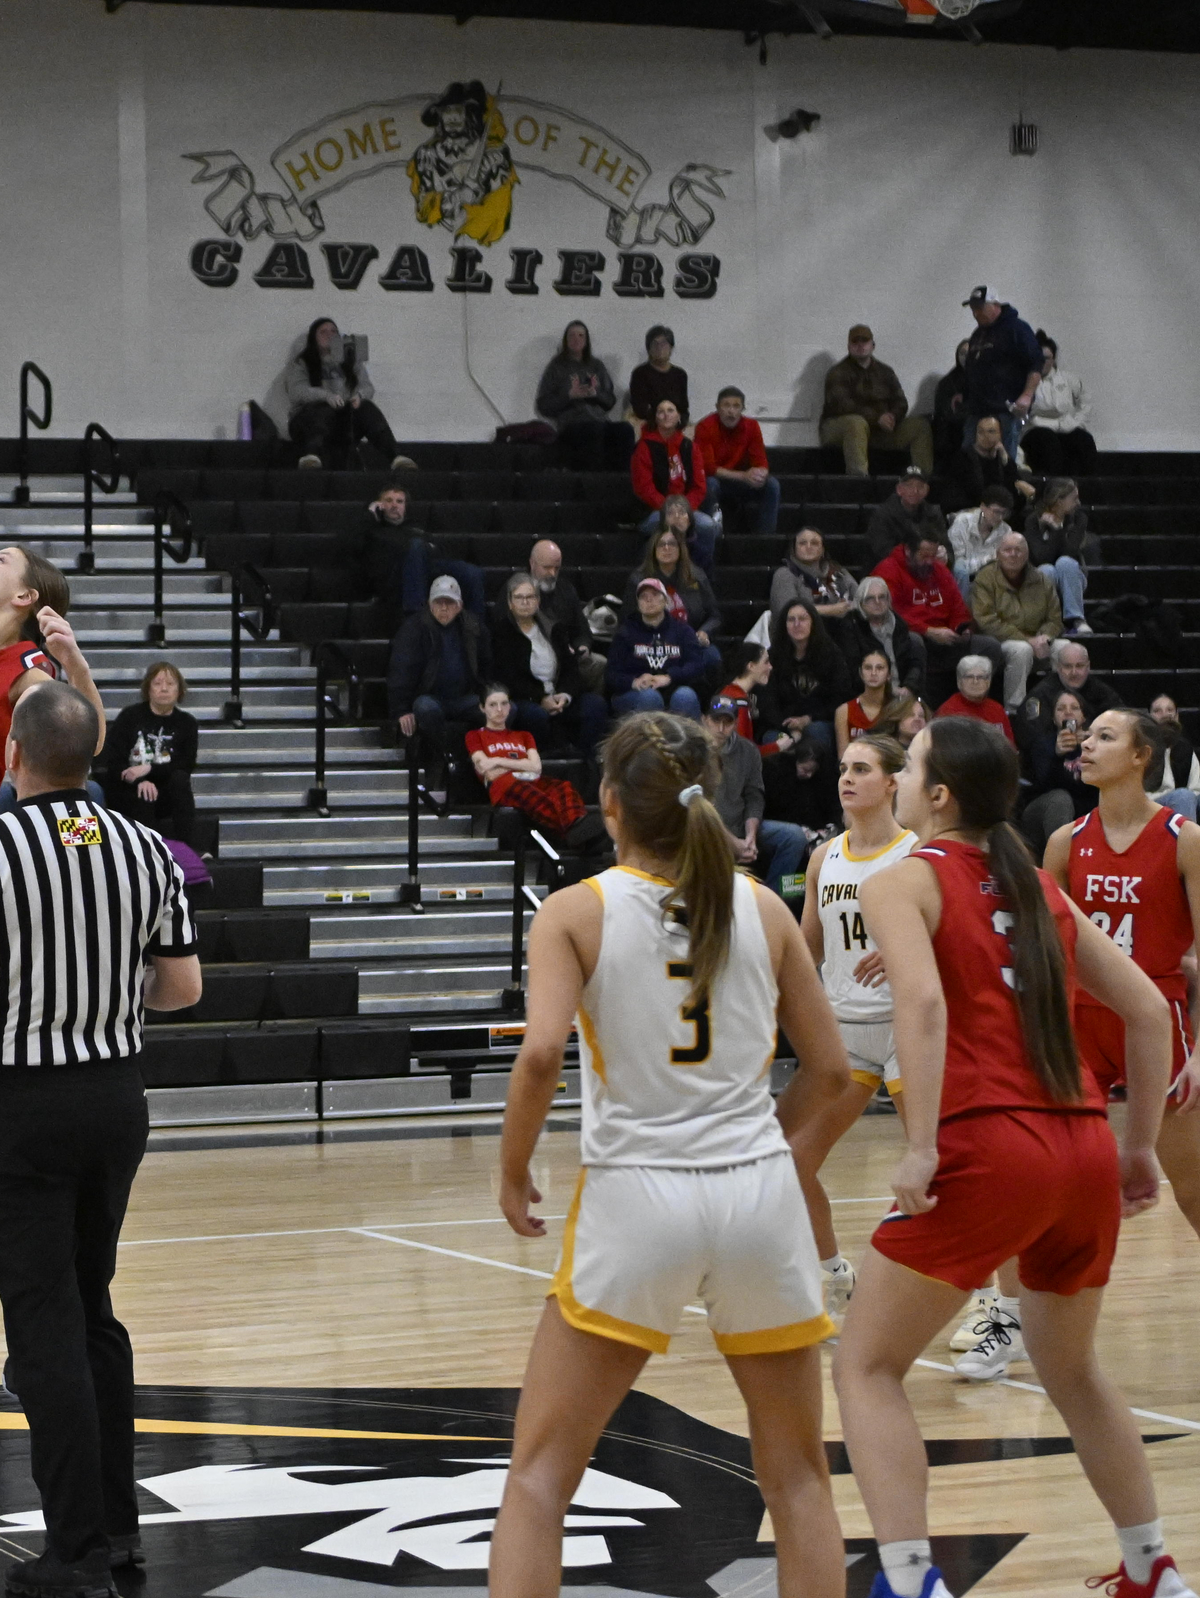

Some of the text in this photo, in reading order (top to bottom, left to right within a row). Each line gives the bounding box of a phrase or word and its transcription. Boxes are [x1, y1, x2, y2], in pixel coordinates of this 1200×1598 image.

[285, 115, 640, 196] HOME OF THE
[188, 238, 720, 298] CAVALIERS
[821, 884, 859, 908] CAVAL
[1085, 874, 1142, 903] FSK
[839, 911, 868, 950] 14
[666, 961, 713, 1065] 3
